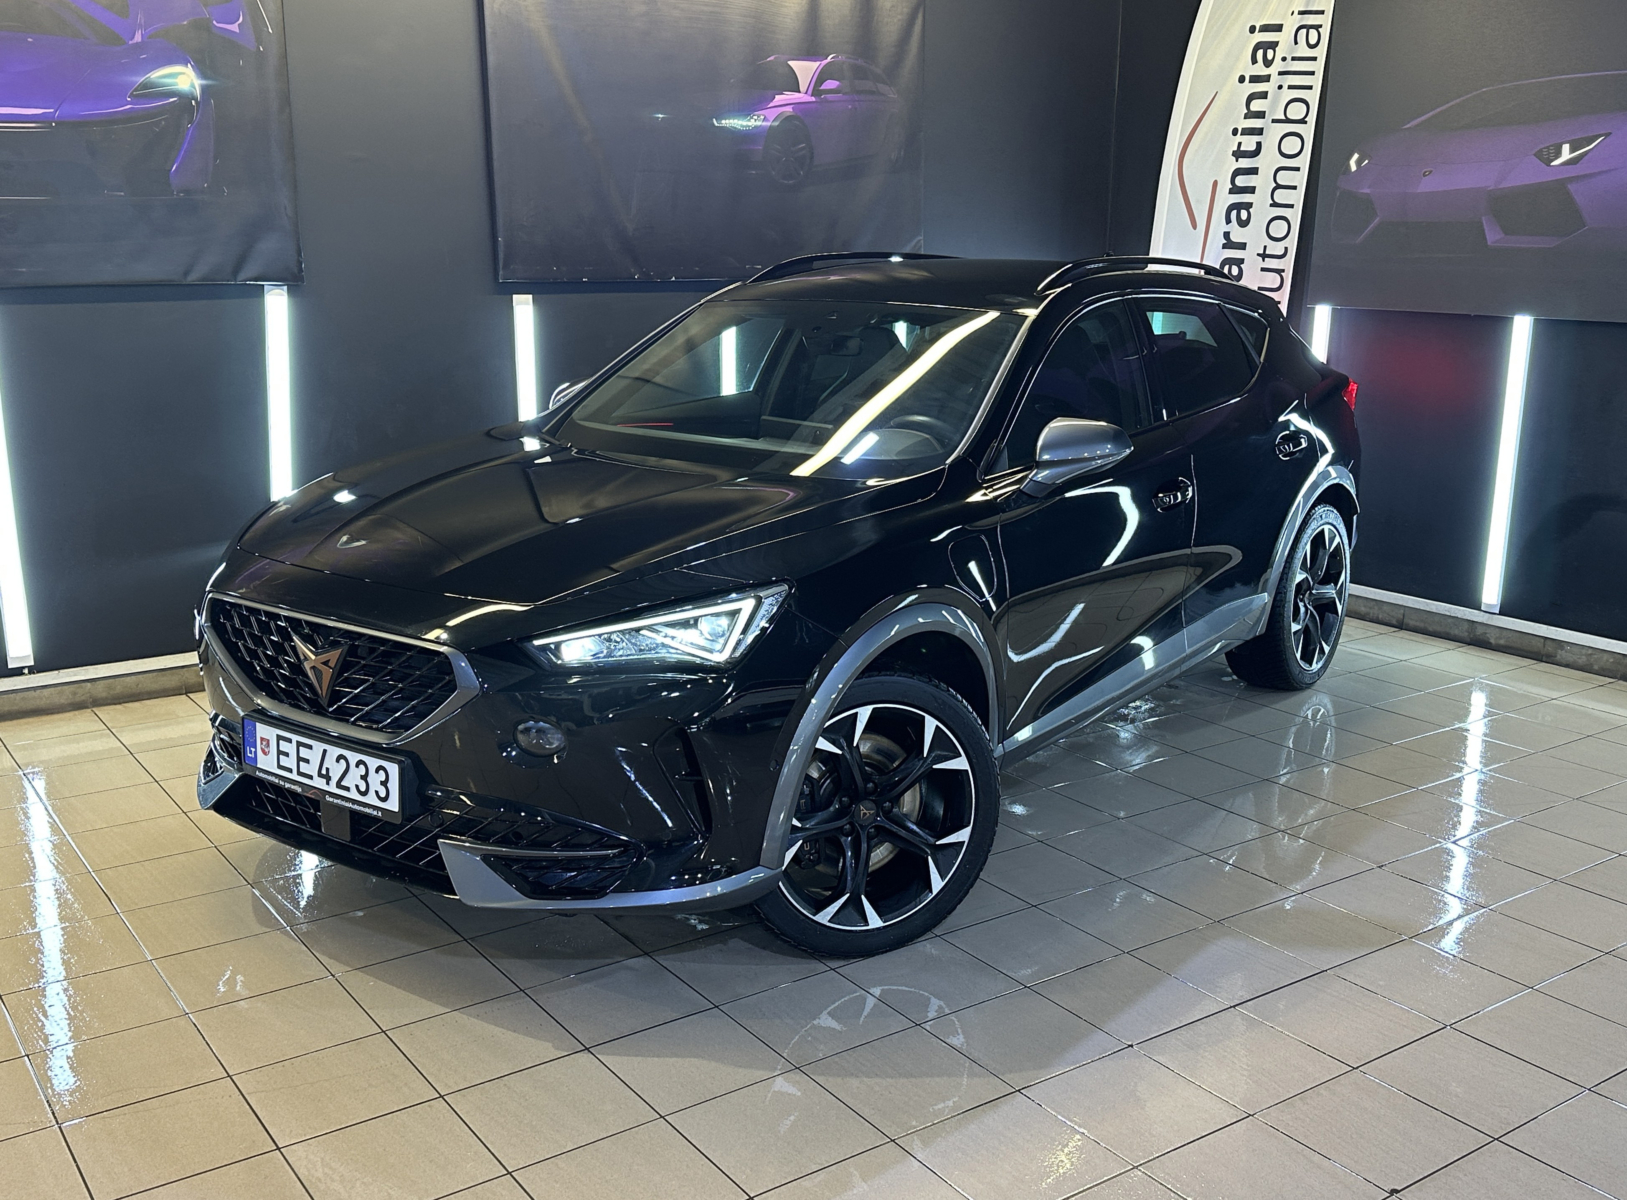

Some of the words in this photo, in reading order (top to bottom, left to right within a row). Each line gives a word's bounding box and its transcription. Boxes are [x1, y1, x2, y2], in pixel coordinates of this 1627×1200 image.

[1219, 23, 1284, 283] arantiniai
[1257, 9, 1326, 305] utomobiliai
[247, 746, 256, 758] LT
[275, 733, 390, 803] EE4233
